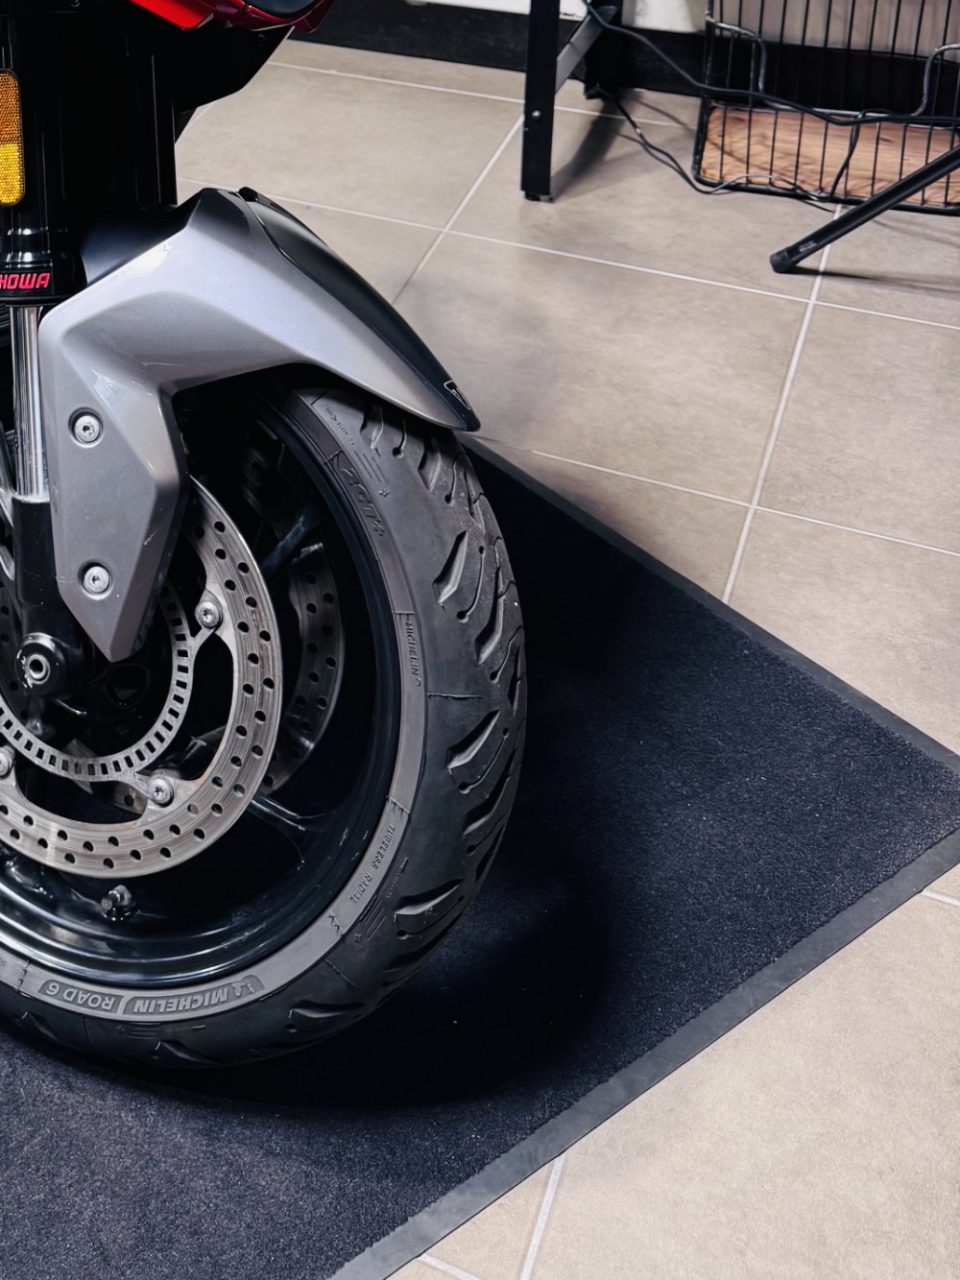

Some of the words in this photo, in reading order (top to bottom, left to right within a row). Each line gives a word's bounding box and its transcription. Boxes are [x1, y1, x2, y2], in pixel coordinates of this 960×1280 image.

[404, 621, 419, 676] MICHELIN
[371, 823, 396, 869] TUBELESS
[350, 872, 372, 904] RADIAL
[45, 982, 60, 996] 6
[62, 990, 116, 1011] ROAD
[134, 986, 228, 1013] MICHELIN
